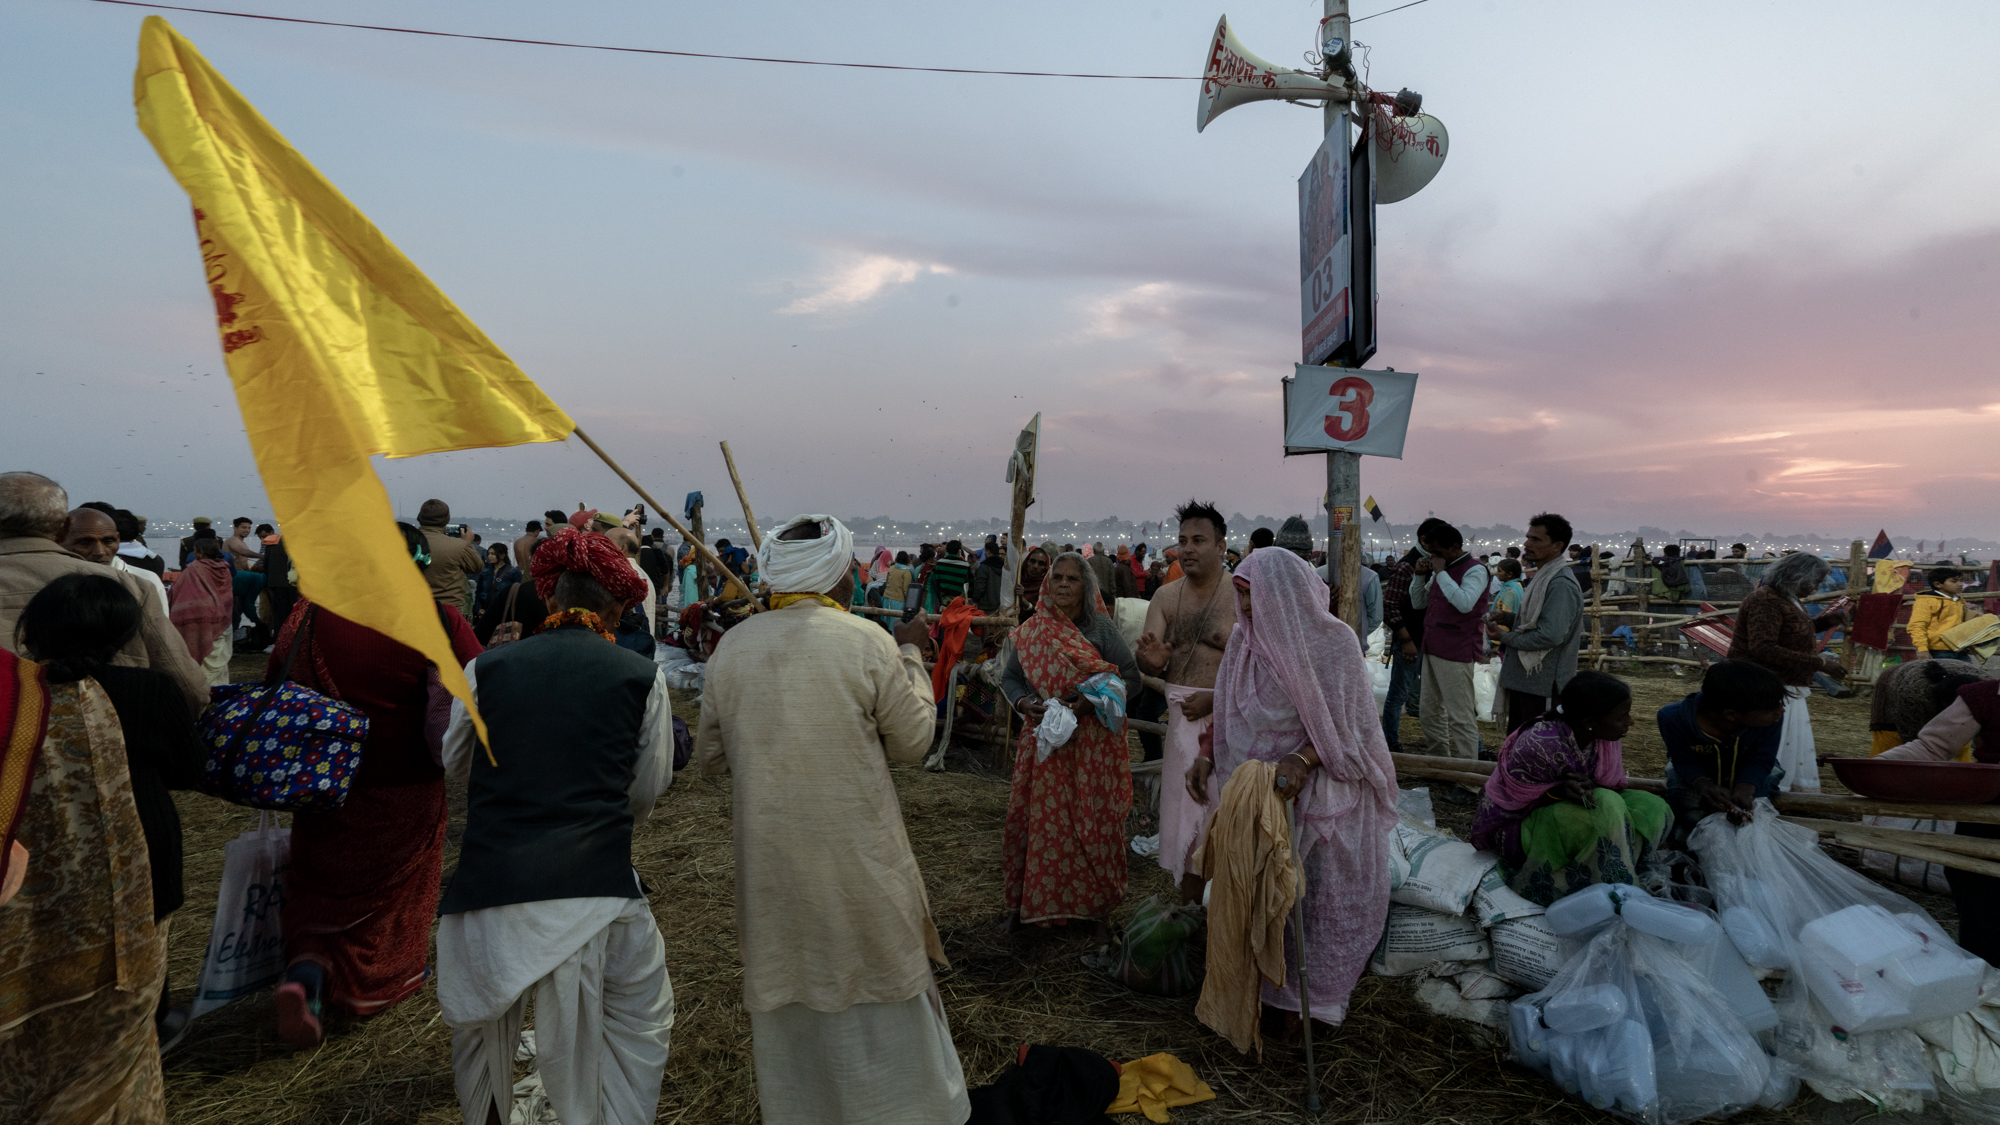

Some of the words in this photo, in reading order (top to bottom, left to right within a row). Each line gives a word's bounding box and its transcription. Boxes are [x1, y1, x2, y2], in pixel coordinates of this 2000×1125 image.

[1312, 256, 1334, 314] 03
[1323, 377, 1375, 442] 3
[1520, 922, 1554, 937] PORTLAND
[1521, 954, 1542, 965] LIMITED
